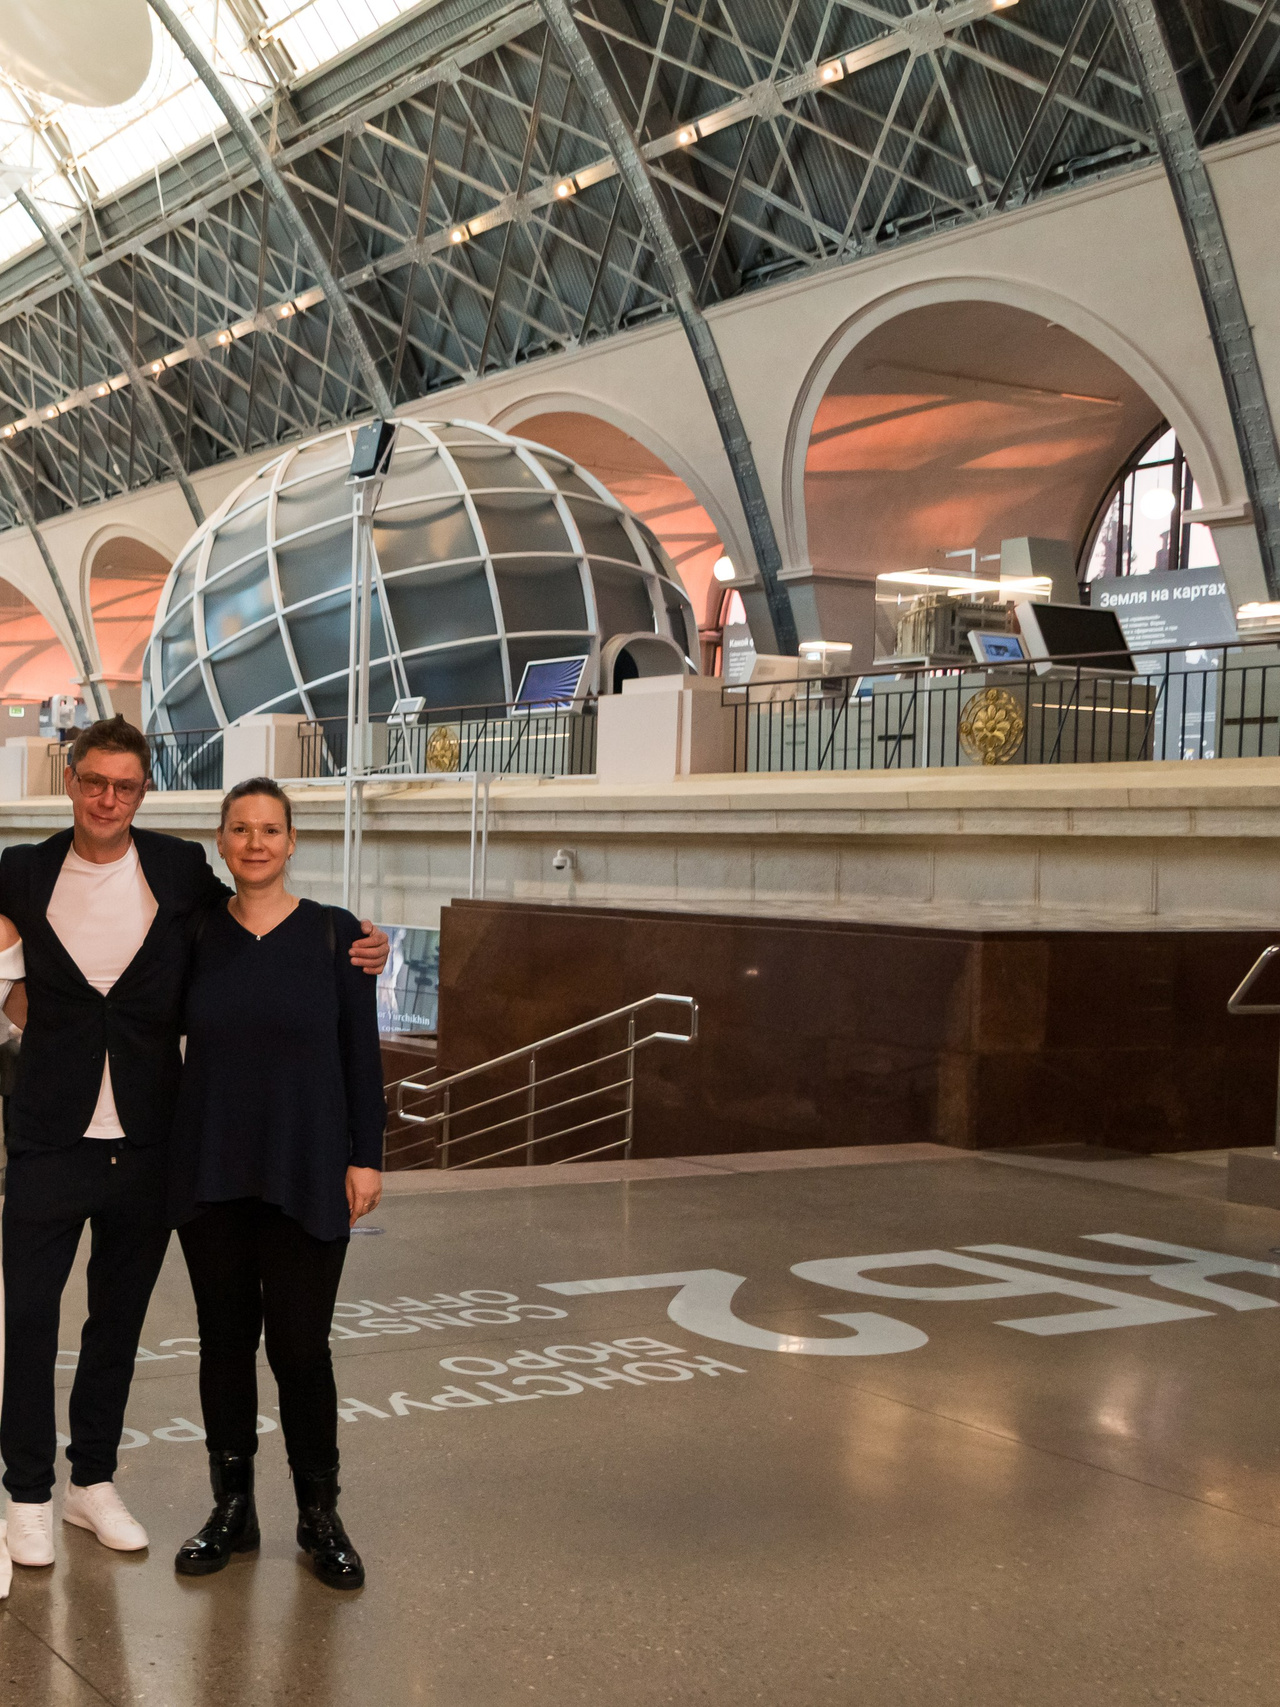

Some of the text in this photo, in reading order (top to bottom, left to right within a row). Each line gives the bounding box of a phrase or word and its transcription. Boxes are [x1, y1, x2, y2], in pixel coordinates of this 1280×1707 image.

[1100, 583, 1226, 607] Земля на картах
[388, 1009, 430, 1026] Yurchikhin
[439, 1337, 686, 1375] БЮРО
